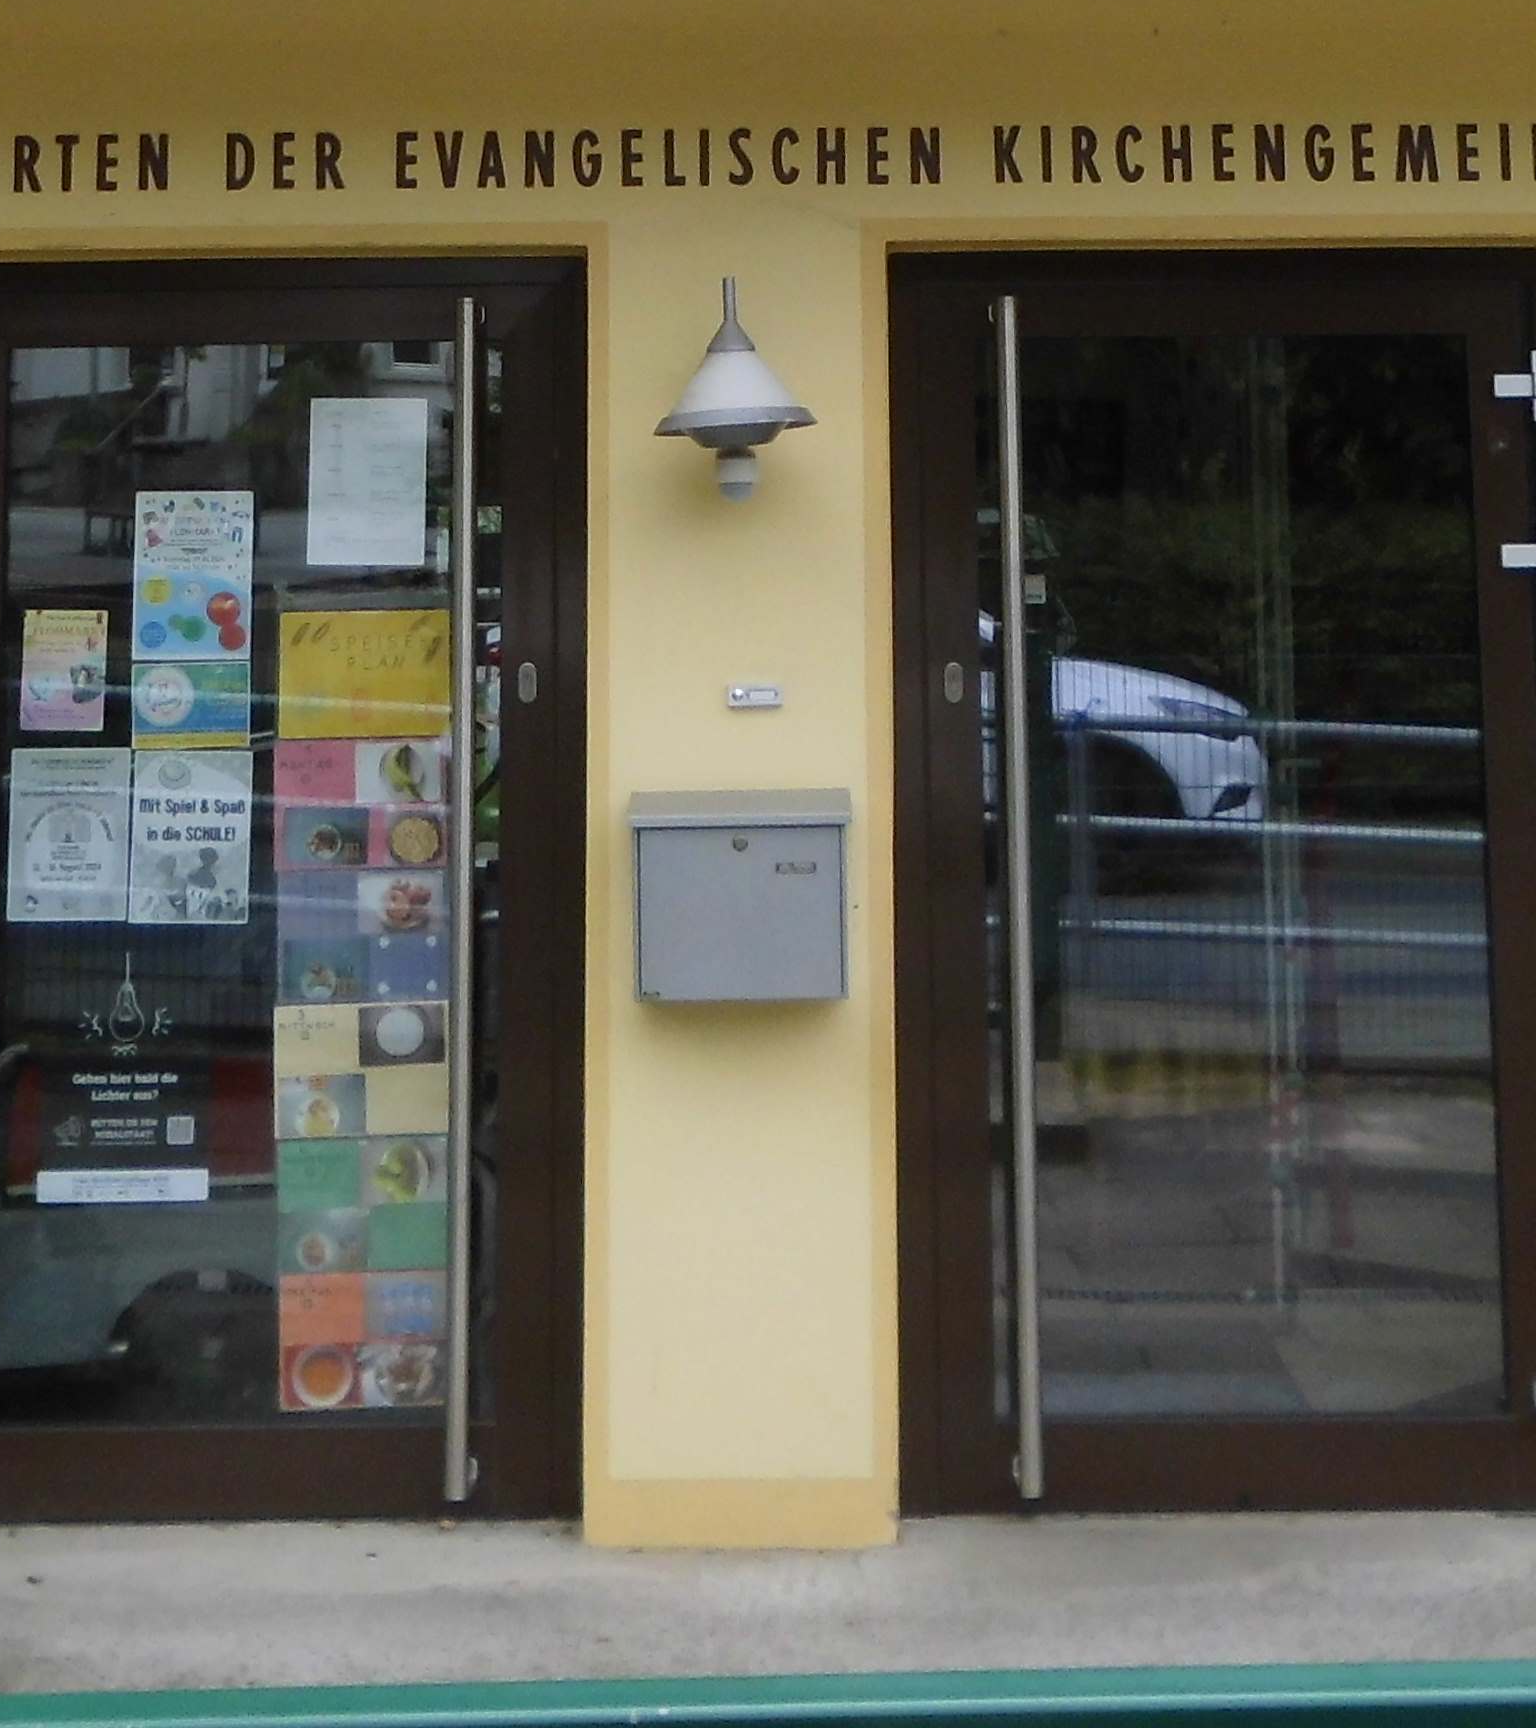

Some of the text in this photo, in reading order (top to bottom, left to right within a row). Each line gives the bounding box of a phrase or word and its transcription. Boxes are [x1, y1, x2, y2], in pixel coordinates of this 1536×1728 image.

[225, 131, 346, 192] DER
[395, 126, 942, 190] EVANGELISCHEN
[139, 798, 246, 817] Mit Spiel & Spaß
[146, 826, 158, 841] in
[161, 826, 182, 841] die
[110, 1073, 133, 1084] hier
[160, 1073, 179, 1083] die
